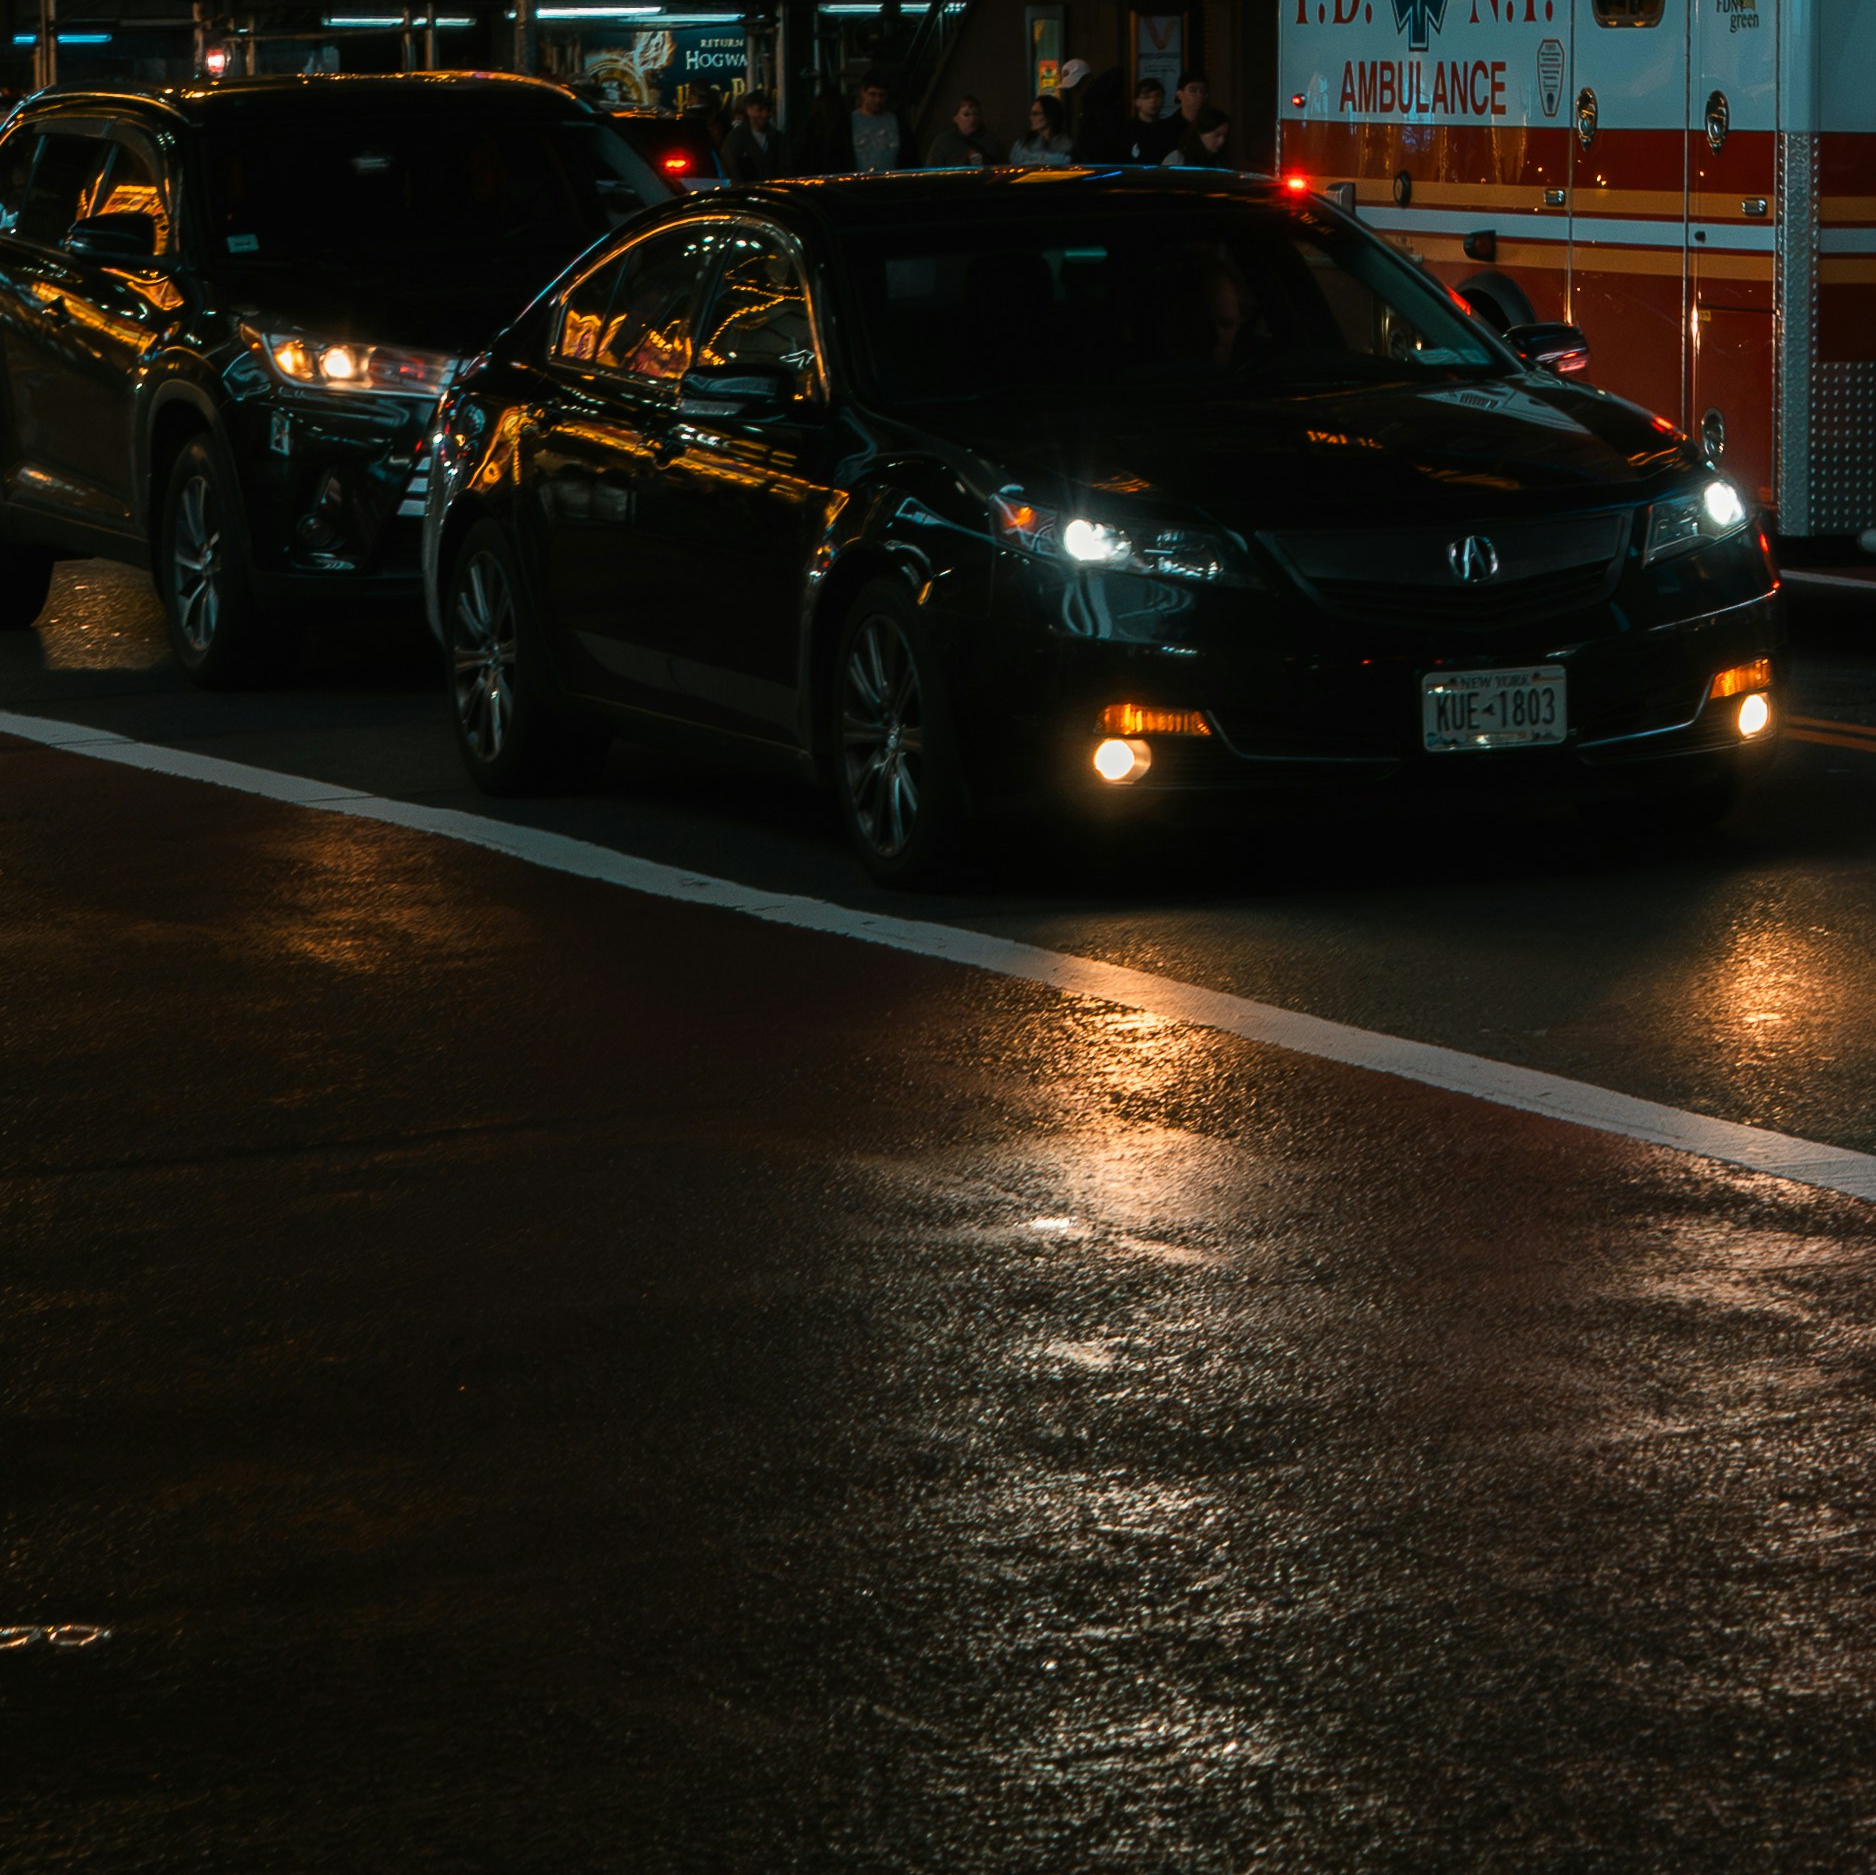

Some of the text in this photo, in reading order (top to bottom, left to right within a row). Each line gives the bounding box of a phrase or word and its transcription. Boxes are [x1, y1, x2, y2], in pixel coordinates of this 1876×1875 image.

[1730, 13, 1759, 33] green
[700, 38, 745, 49] RETURN
[1339, 60, 1507, 115] AMBULANCE
